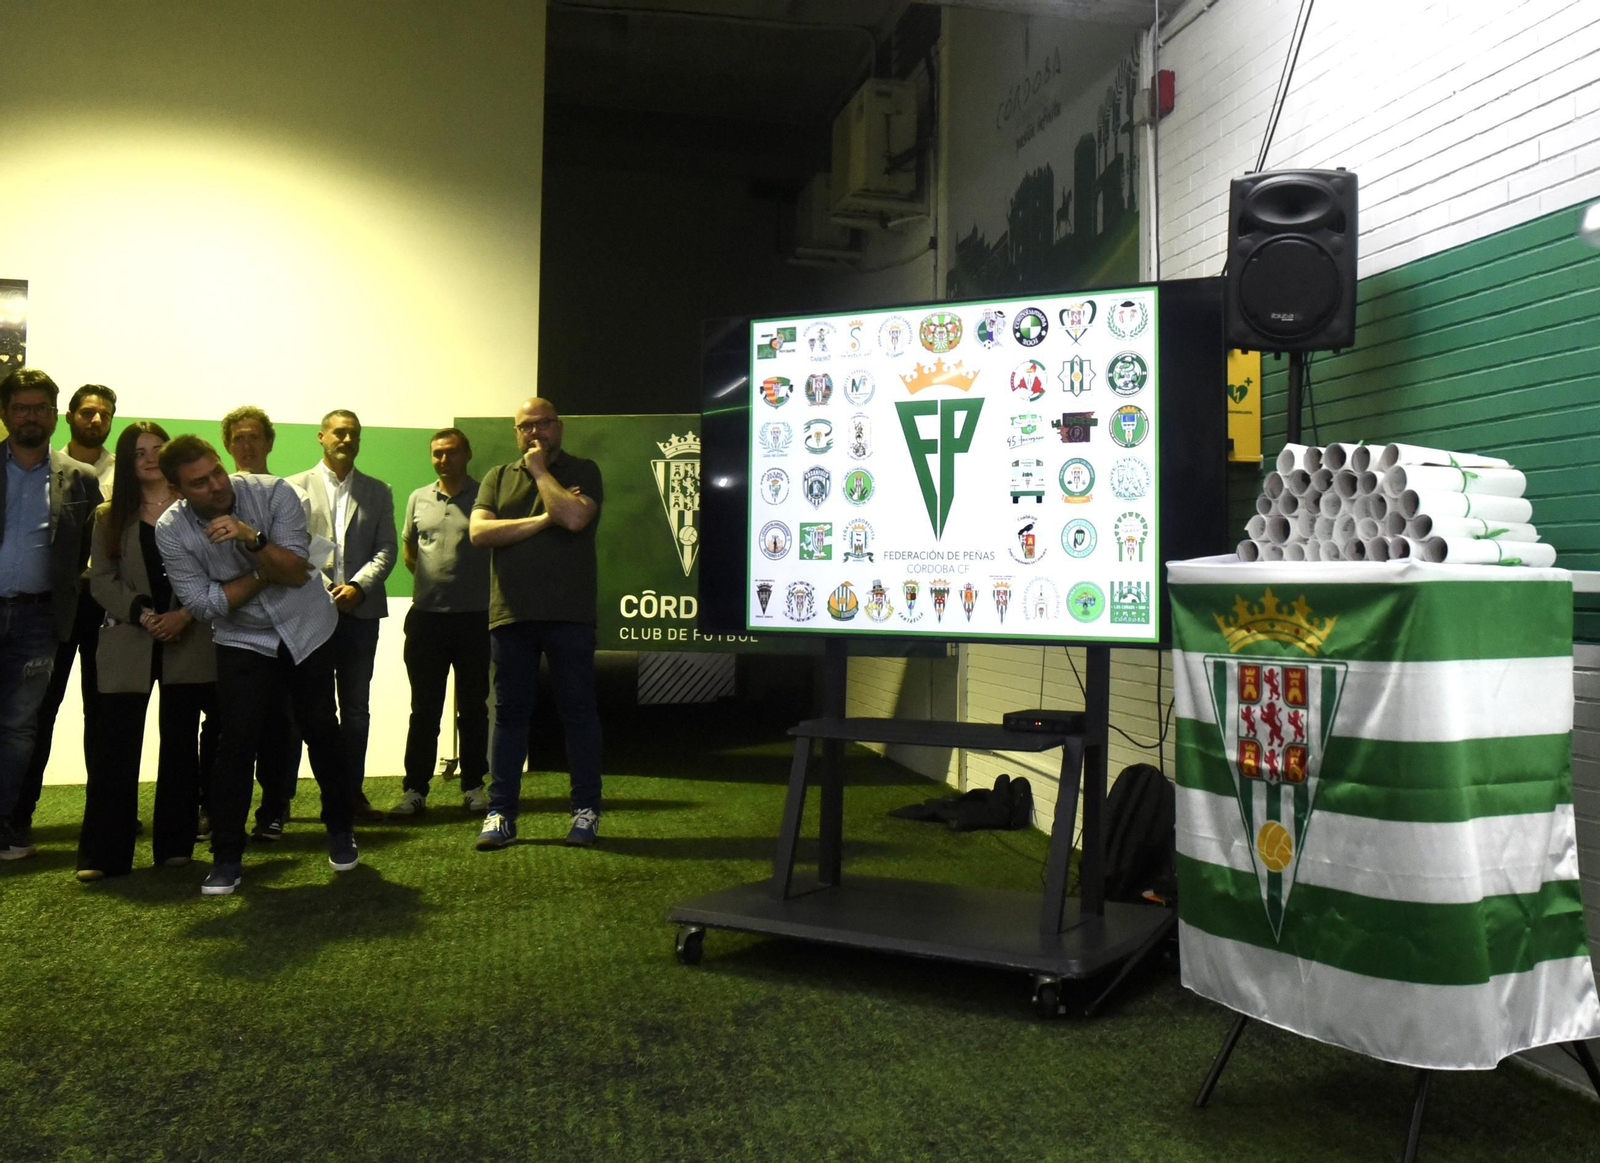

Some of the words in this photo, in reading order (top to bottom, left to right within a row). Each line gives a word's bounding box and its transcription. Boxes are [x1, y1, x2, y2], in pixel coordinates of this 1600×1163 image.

[848, 518, 875, 540] CORDOBESISTA
[883, 549, 944, 560] FEDERACIÓN
[947, 551, 960, 560] DE
[963, 549, 995, 560] PEÑAS
[906, 563, 955, 574] CÓRDOBA
[958, 564, 970, 574] CF
[619, 627, 662, 640] CLUB
[668, 628, 687, 640] DE
